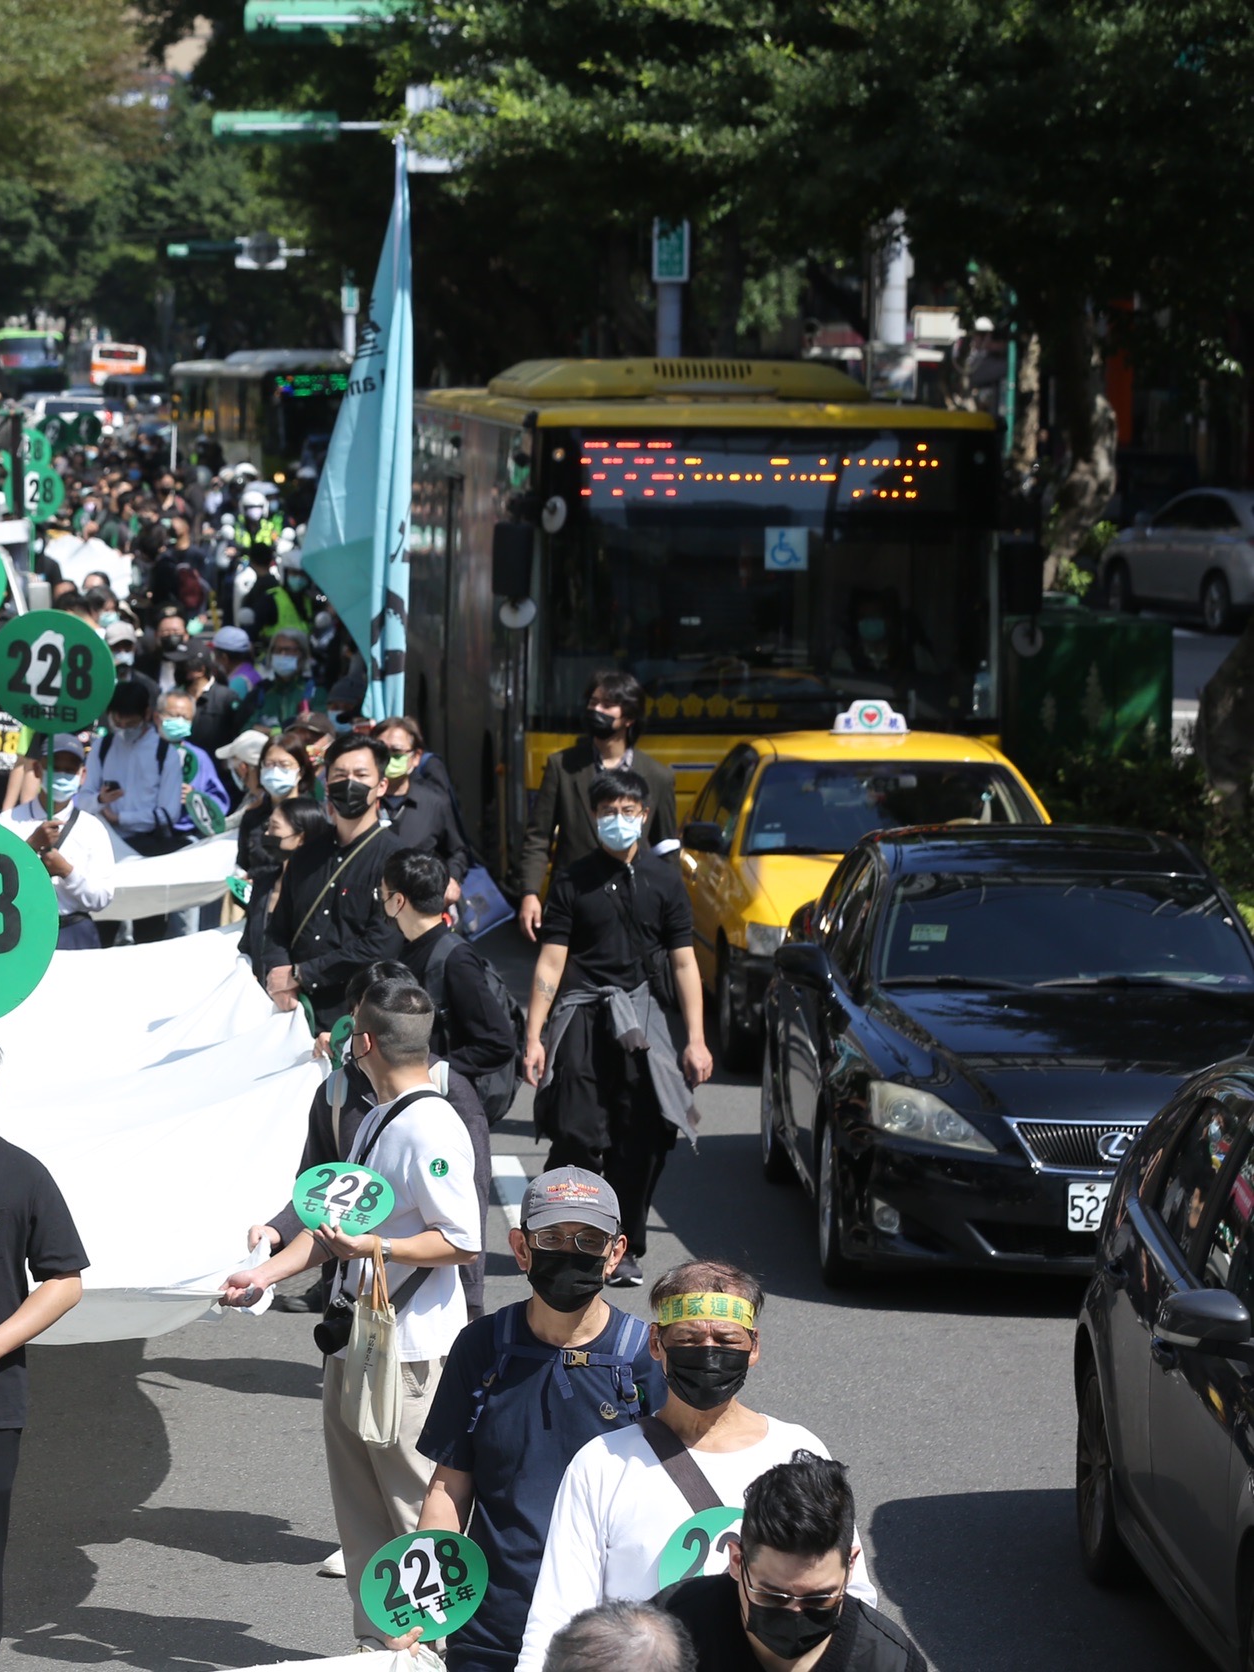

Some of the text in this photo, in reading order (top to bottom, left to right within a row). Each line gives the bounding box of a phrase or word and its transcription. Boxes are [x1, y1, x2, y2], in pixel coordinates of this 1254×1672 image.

[29, 477, 54, 504] 28
[7, 639, 93, 701] 228
[22, 704, 77, 723] 和平日
[306, 1168, 384, 1212] 228
[302, 1199, 371, 1226] 七十五年
[1070, 1195, 1107, 1225] 52
[374, 1538, 468, 1612] 228
[390, 1584, 476, 1627] 七十五年
